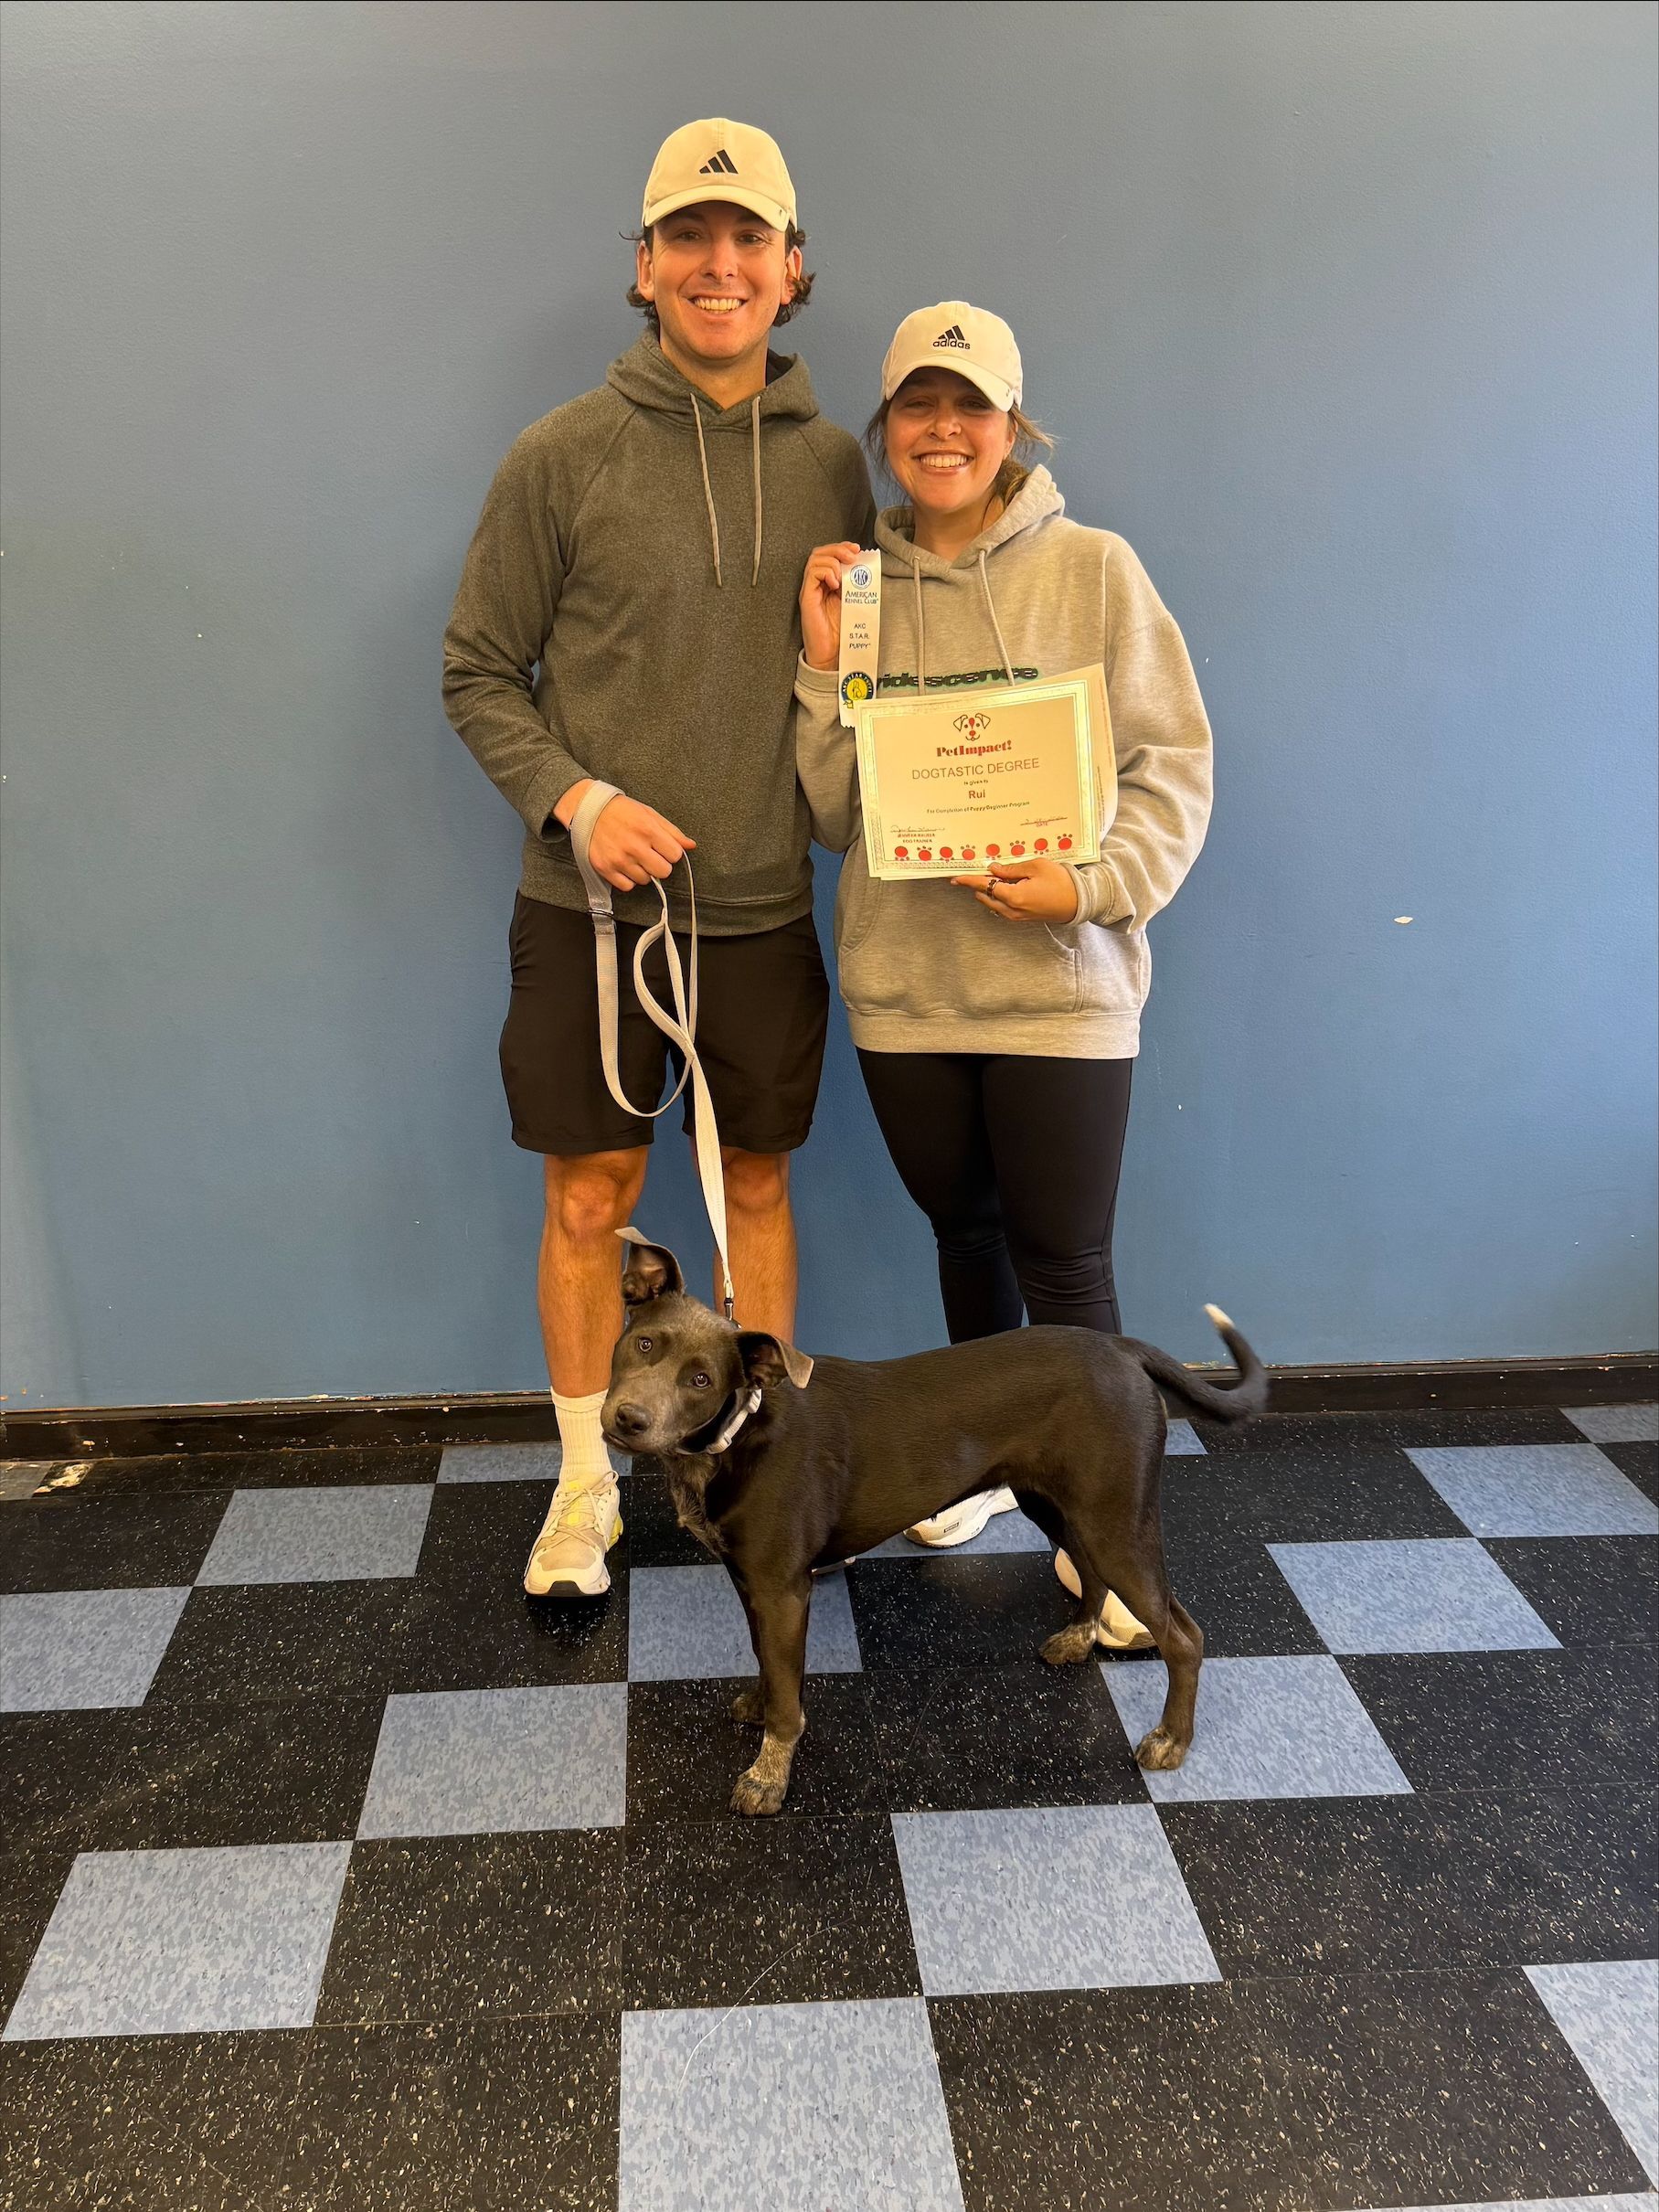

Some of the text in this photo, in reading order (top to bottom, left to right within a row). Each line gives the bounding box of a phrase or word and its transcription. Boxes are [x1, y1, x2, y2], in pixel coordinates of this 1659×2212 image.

[932, 338, 971, 349] adidas
[845, 590, 877, 599] AMERICAN
[936, 739, 1012, 757] PetImpact!
[911, 757, 1040, 780] DOGTASTIC DEGREE
[968, 790, 986, 799] Rui
